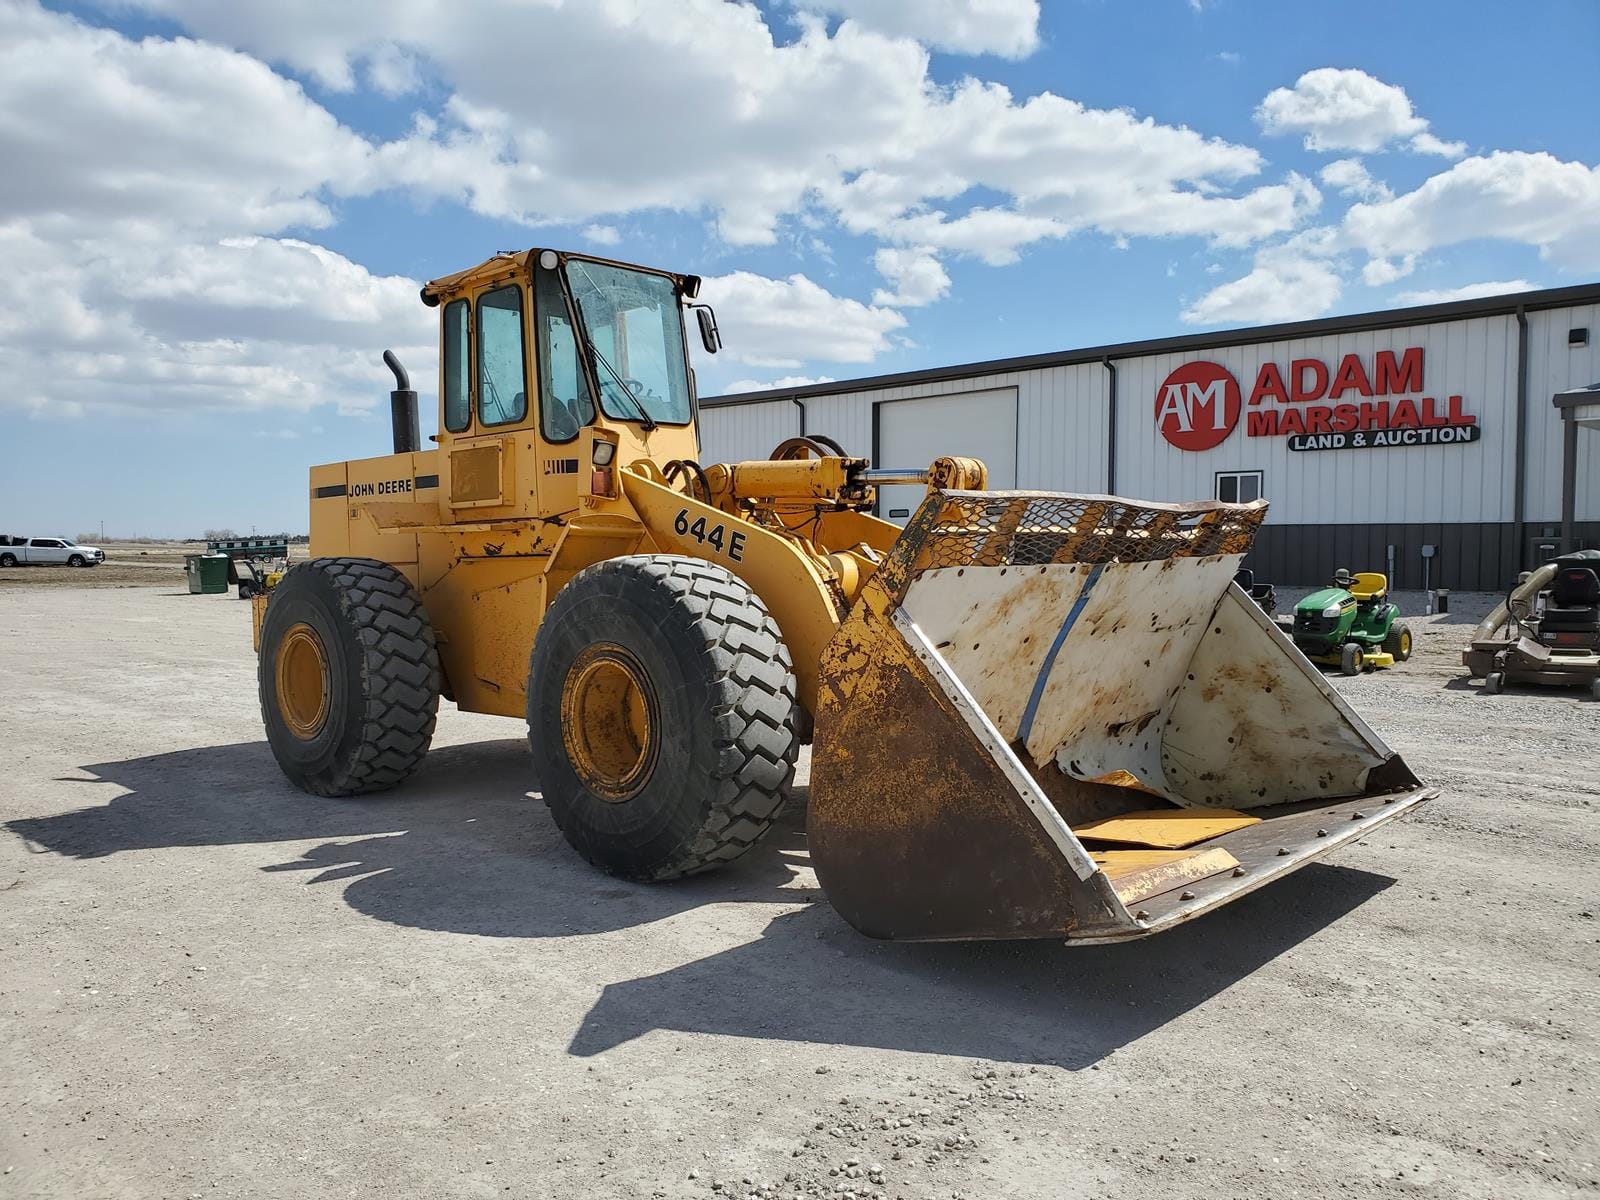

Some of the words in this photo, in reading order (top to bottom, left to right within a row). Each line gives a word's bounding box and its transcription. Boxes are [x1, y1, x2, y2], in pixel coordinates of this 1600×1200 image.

[1248, 347, 1424, 405] ADAM
[1160, 379, 1229, 433] AM
[1247, 395, 1477, 437] MARSHALL
[1294, 434, 1346, 450] LAND
[1352, 432, 1367, 447] &
[1373, 426, 1472, 446] AUCTION
[349, 483, 375, 497] JOHN
[378, 479, 412, 494] DEERE
[674, 508, 747, 563] 644E
